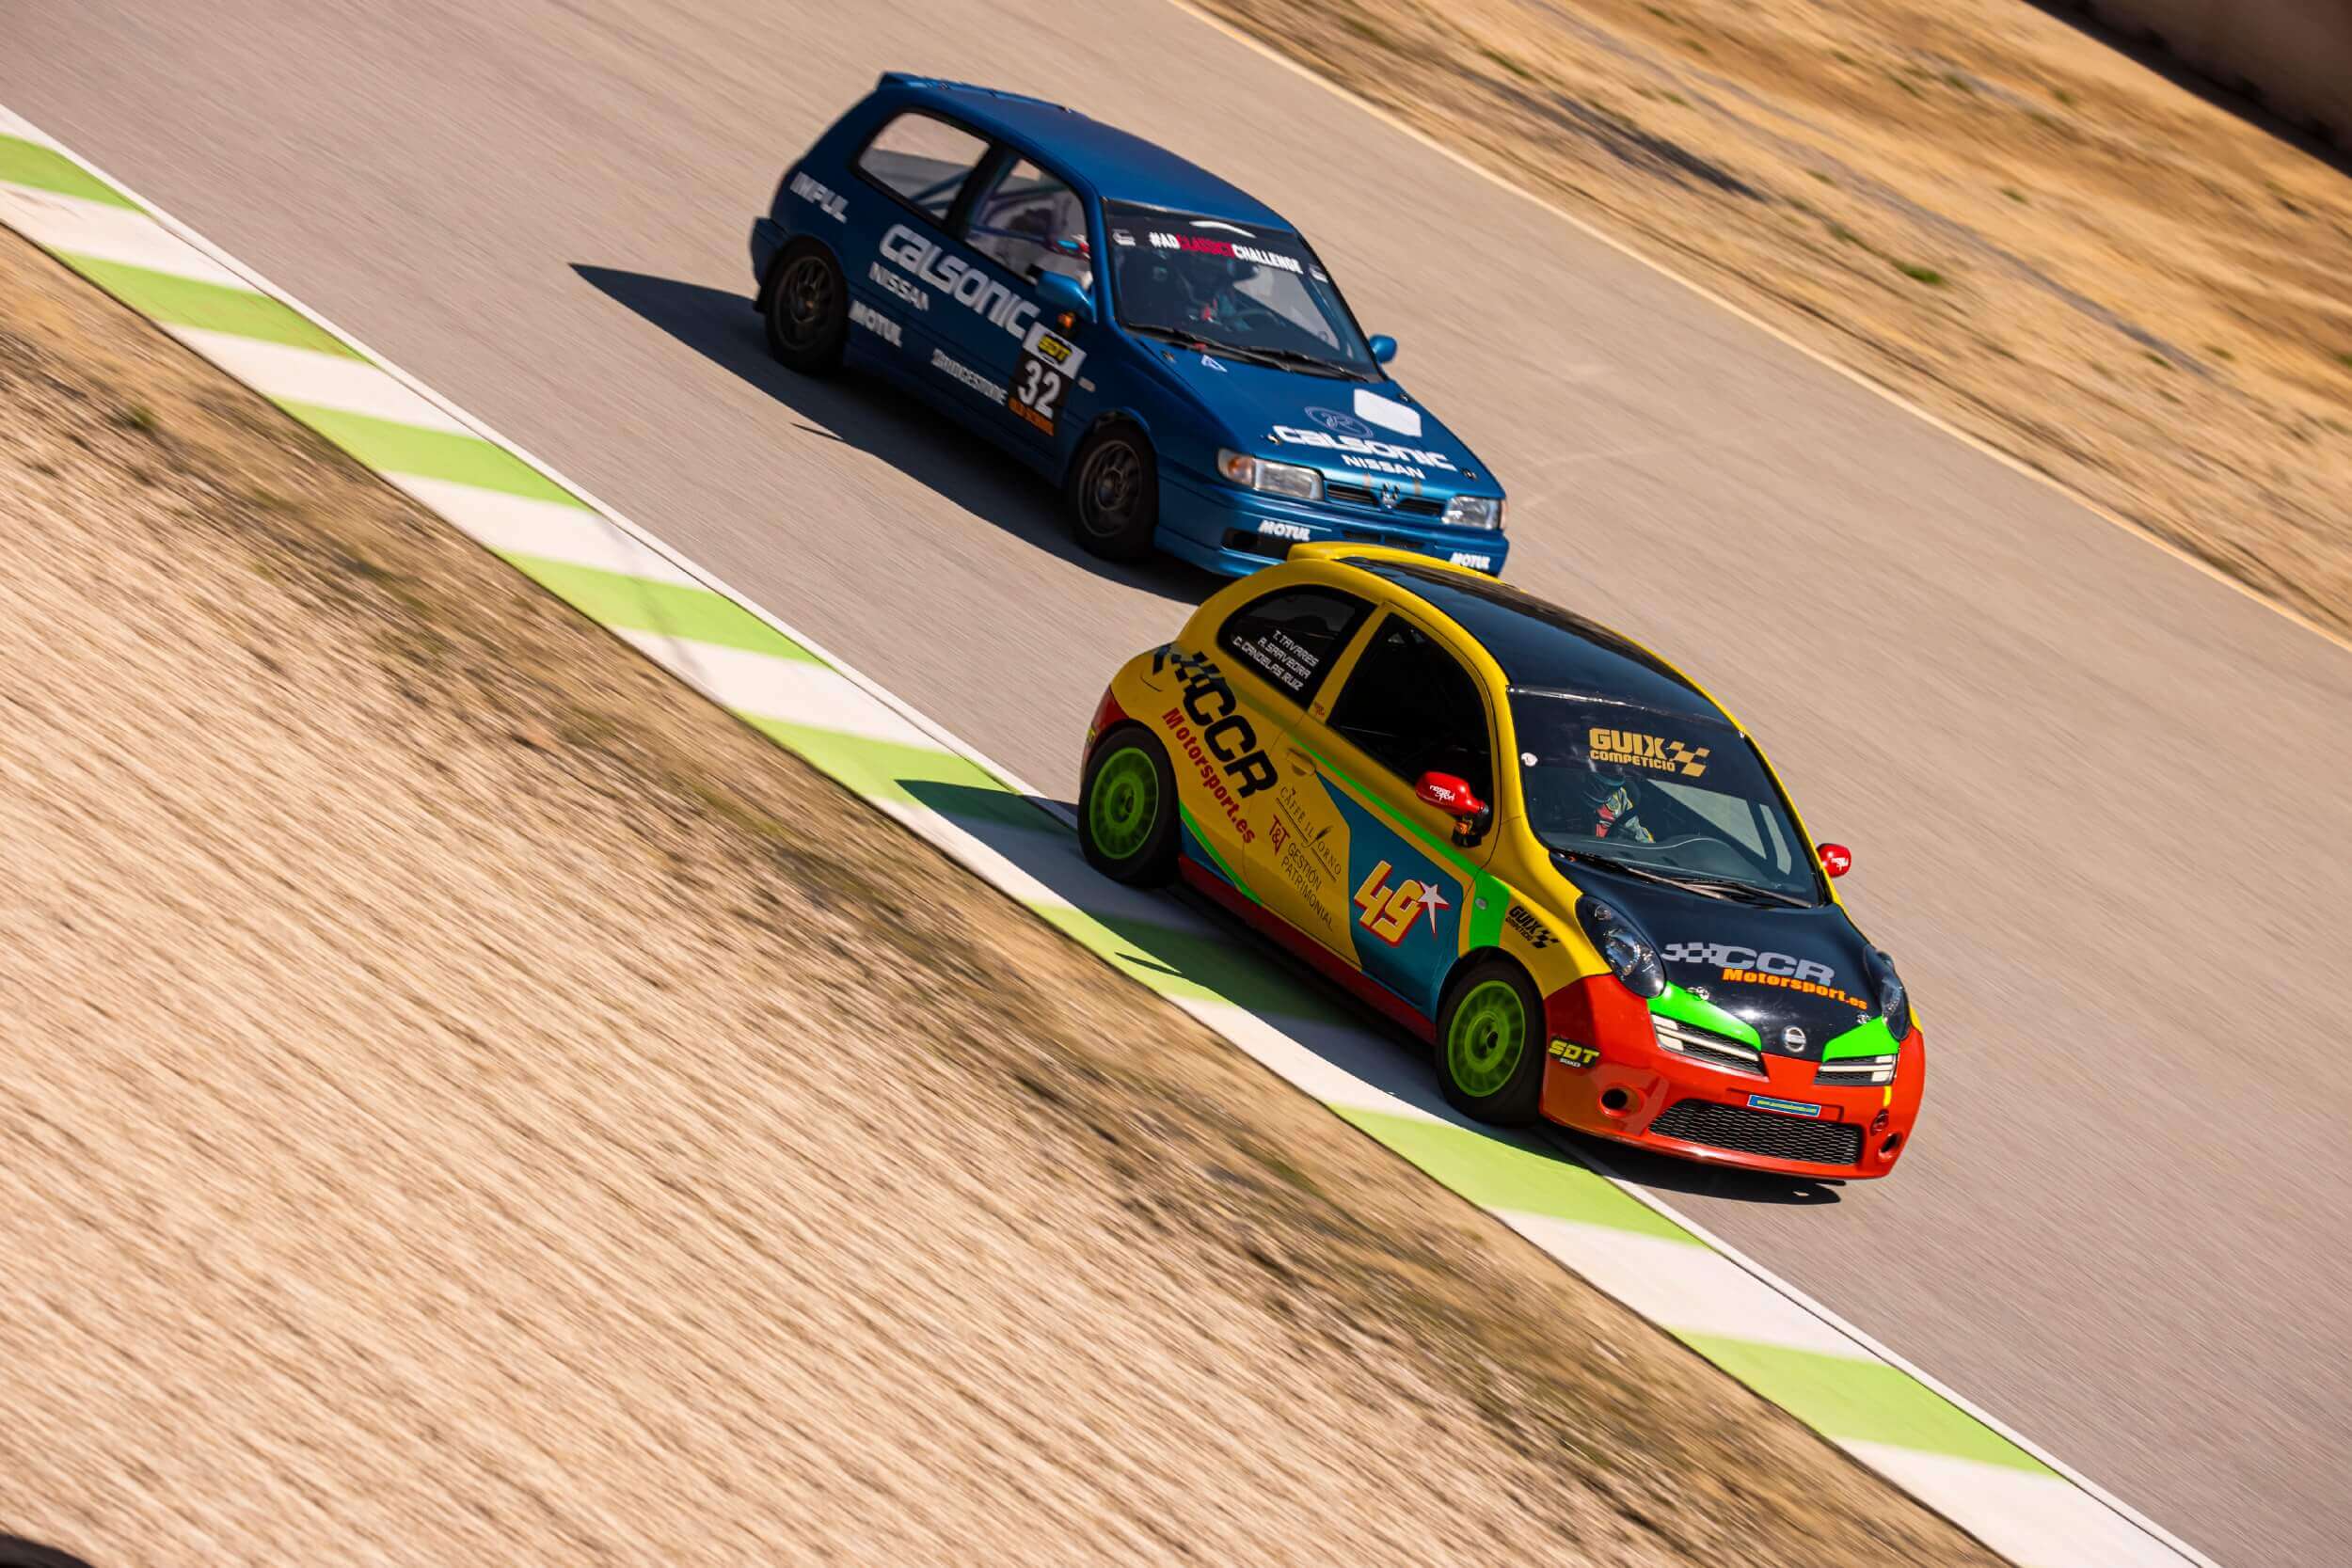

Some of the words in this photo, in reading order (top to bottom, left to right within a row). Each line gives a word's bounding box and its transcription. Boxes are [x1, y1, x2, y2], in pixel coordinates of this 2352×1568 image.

[868, 261, 929, 311] NISSAN
[848, 299, 903, 347] MOTUL
[1017, 359, 1062, 420] 32
[1342, 454, 1426, 480] NISSAN
[1258, 519, 1311, 541] MOTUL
[1450, 552, 1491, 571] MOTUL
[1281, 672, 1304, 691] RUIZ
[1183, 675, 1279, 799] CCR
[1589, 728, 1667, 760] GUIX
[1162, 707, 1256, 844] Motorsport.es
[1269, 814, 1291, 856] T&T
[1288, 842, 1322, 892] GESTIÓN
[1281, 857, 1333, 932] PATRIMONIAL
[1354, 860, 1424, 947] 49
[1509, 906, 1538, 935] GUIX
[1714, 944, 1835, 987] CCR
[1721, 967, 1868, 1010] Motorsport.es
